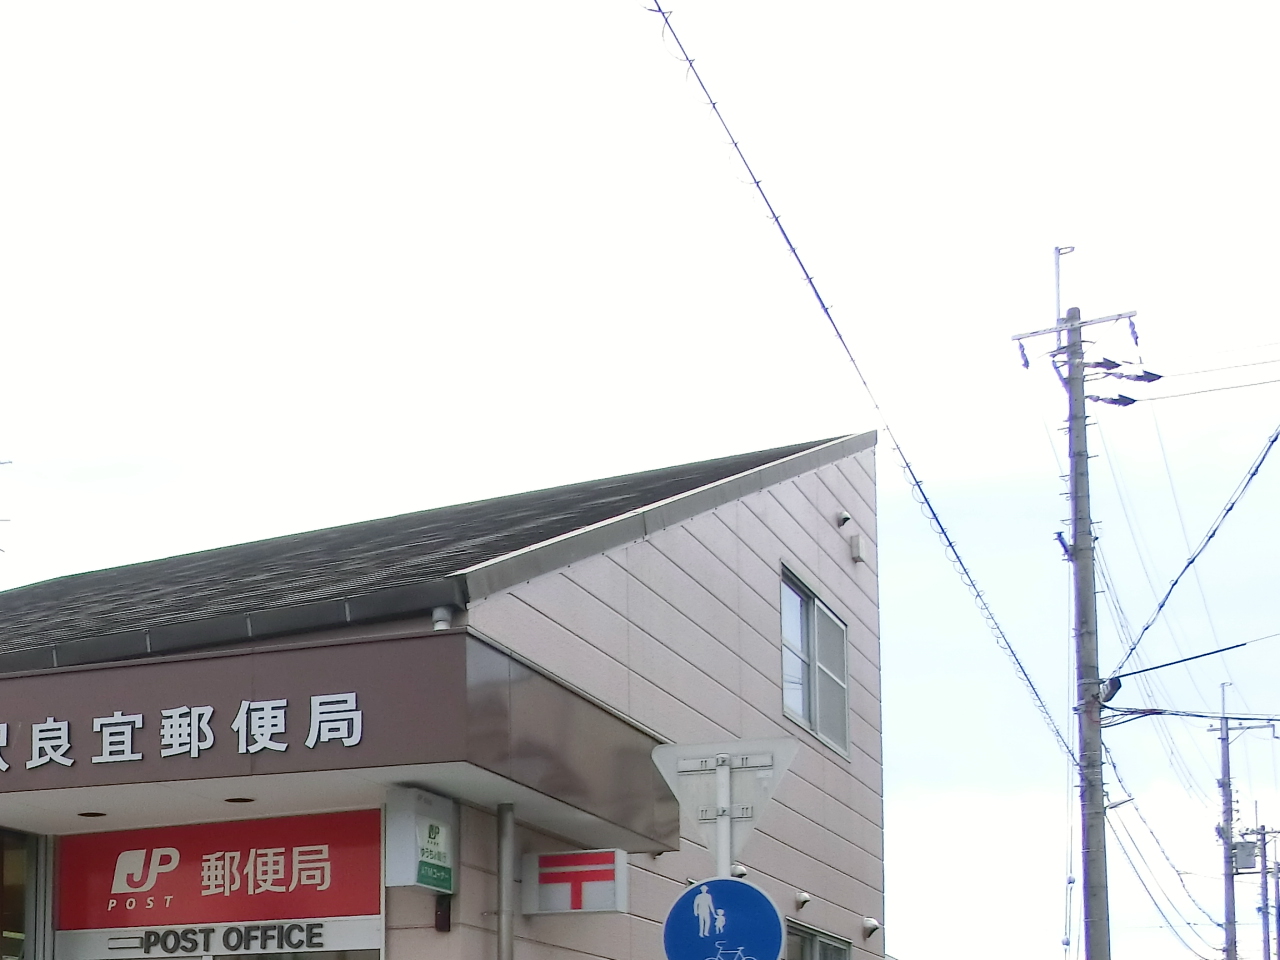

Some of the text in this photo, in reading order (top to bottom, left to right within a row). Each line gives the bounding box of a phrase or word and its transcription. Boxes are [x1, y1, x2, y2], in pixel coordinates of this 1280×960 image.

[201, 844, 332, 897] 郵便局
[107, 895, 174, 911] POST
[143, 923, 324, 954] POST OFFICE
